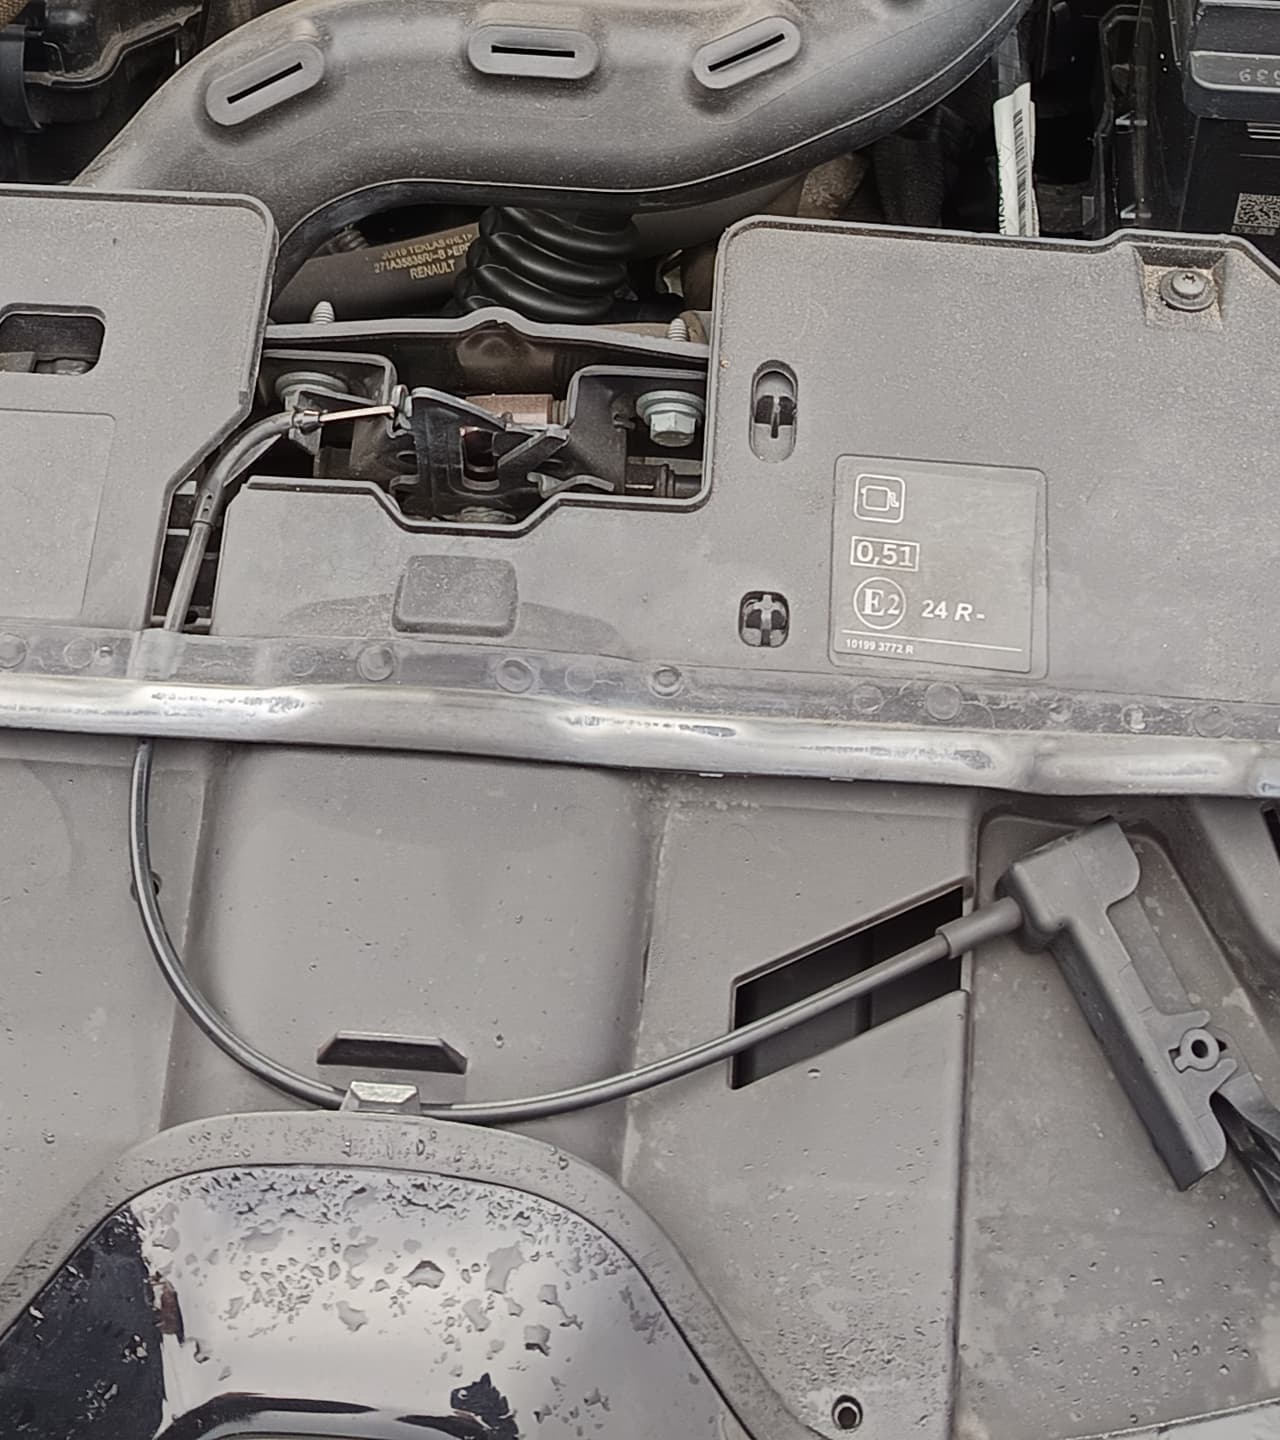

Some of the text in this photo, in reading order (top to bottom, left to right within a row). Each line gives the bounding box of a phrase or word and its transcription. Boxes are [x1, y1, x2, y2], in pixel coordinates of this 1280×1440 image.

[409, 259, 456, 280] RENAULT
[856, 540, 915, 568] 0,51
[861, 588, 901, 616] E2
[921, 600, 948, 619] 24
[878, 640, 903, 654] 3772
[905, 644, 914, 655] R
